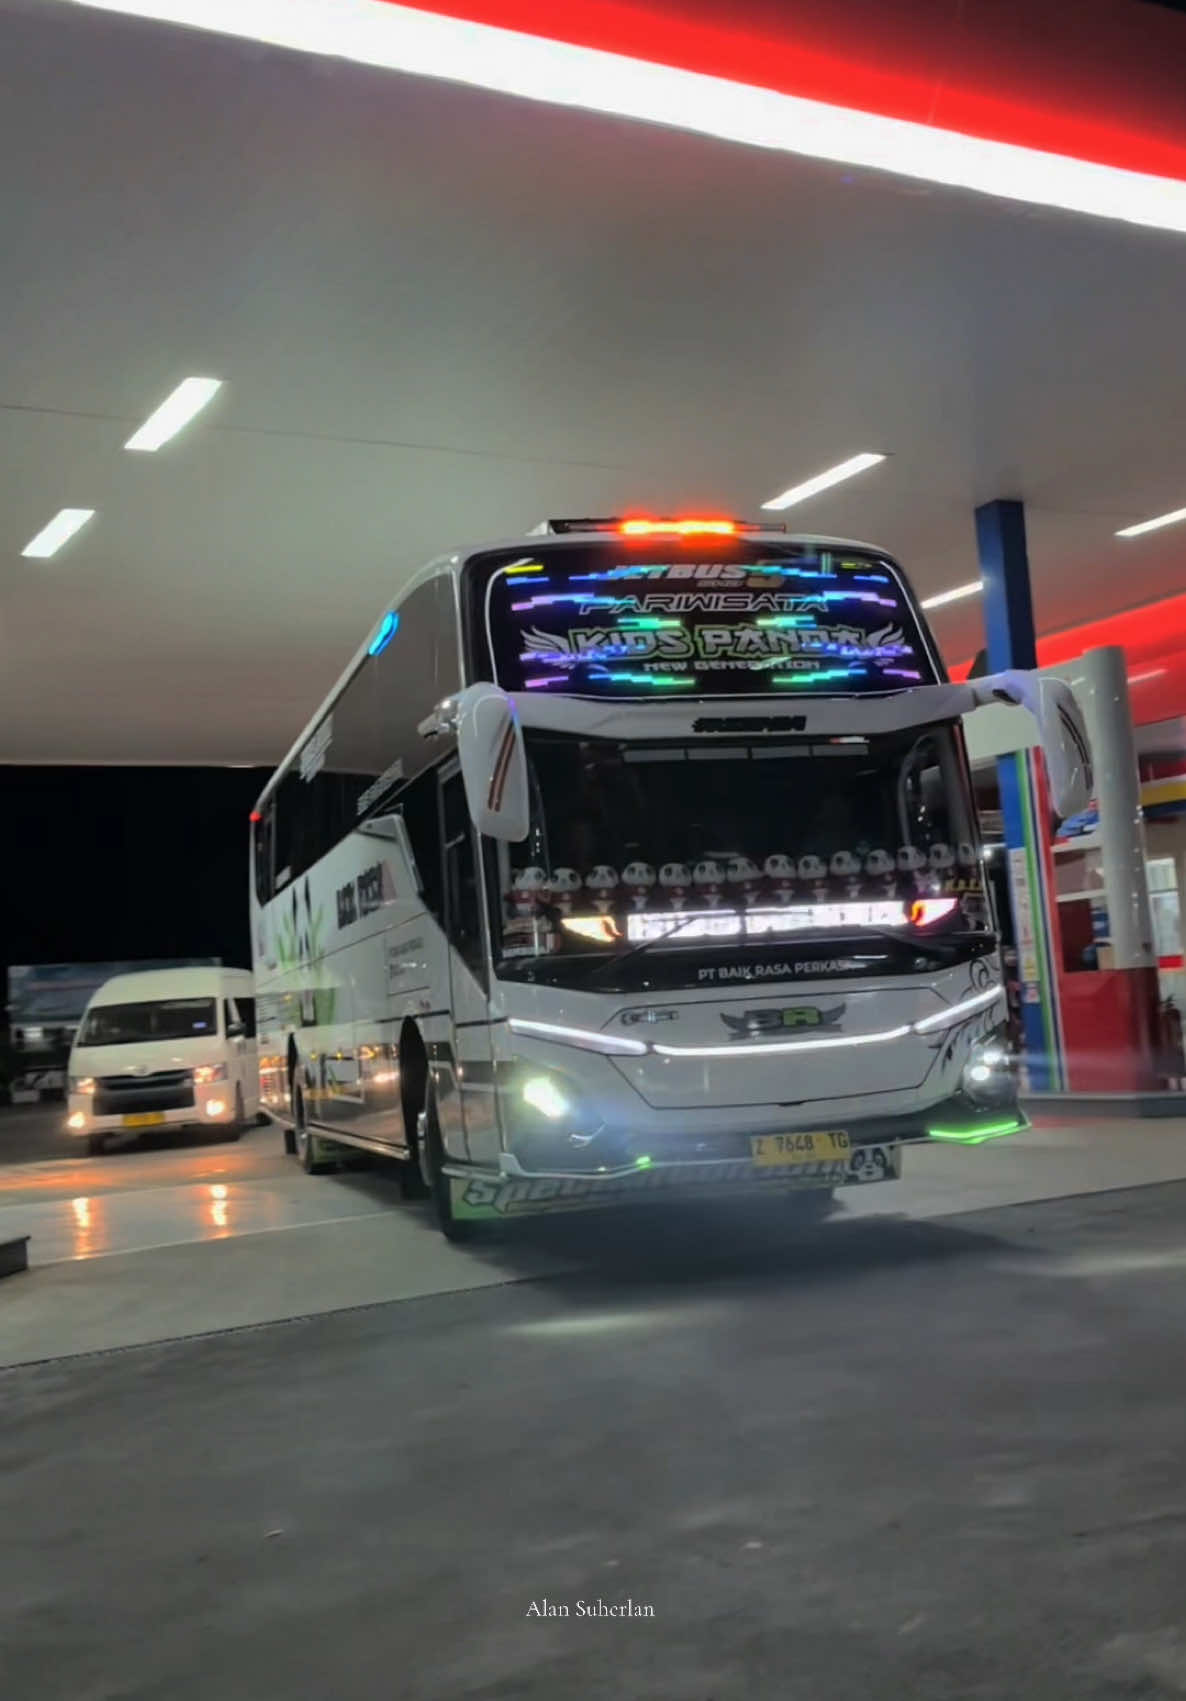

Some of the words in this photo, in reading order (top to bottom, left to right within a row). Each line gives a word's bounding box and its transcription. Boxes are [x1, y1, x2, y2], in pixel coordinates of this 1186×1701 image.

[579, 593, 829, 615] PARIWISATA
[570, 629, 690, 659] KIDS
[698, 625, 865, 658] PANDA
[643, 661, 686, 671] NEW
[693, 660, 818, 670] GENERTION
[698, 968, 714, 980] PT
[718, 965, 752, 979] BAIK
[755, 964, 791, 977] RASA
[774, 1135, 814, 1152] 7648
[827, 1132, 848, 1149] TG
